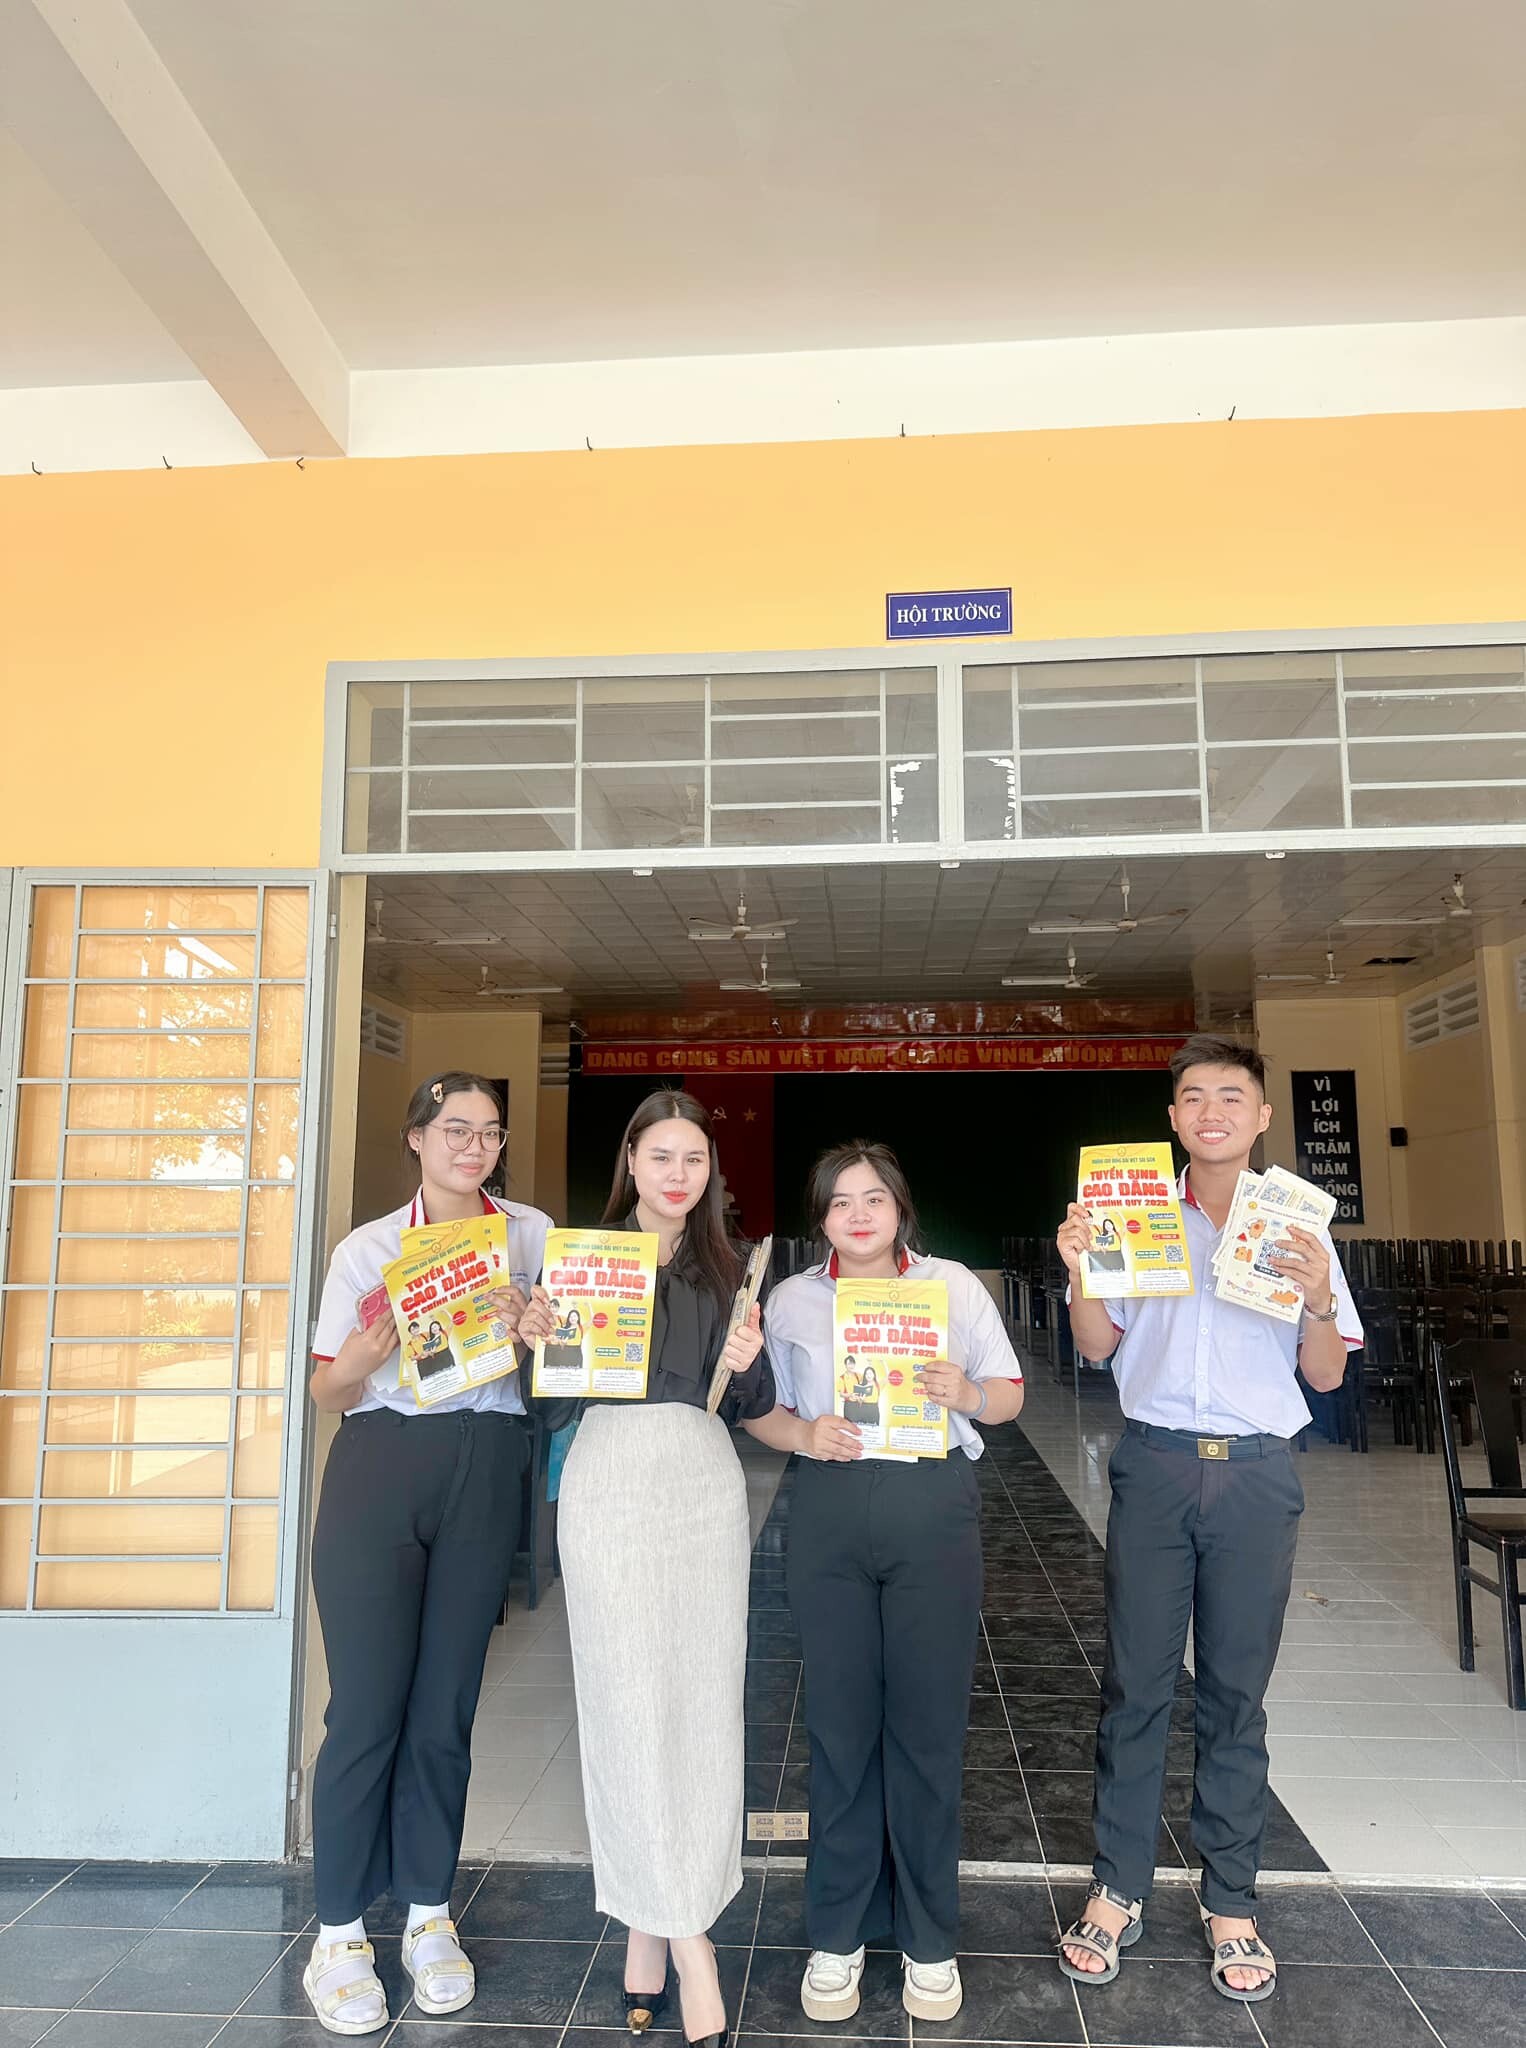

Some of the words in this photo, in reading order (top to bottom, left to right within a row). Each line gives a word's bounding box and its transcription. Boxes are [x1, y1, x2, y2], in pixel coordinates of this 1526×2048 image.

[896, 604, 927, 626] HỘI
[932, 602, 1001, 622] TRƯỜNG
[586, 1048, 649, 1068] ĐẢNG
[726, 1046, 770, 1065] SẢN
[835, 1049, 886, 1065] NAM
[977, 1048, 1035, 1064] VINH
[1314, 1076, 1331, 1091] VÌ
[1312, 1098, 1339, 1115] LỢI
[1314, 1118, 1340, 1133] ÍCH
[1304, 1139, 1351, 1154] TRĂM
[1090, 1166, 1124, 1180] TUYỂN
[1127, 1169, 1158, 1180] SINH
[1312, 1160, 1348, 1175] NĂM
[1082, 1182, 1112, 1198] CAO
[561, 1252, 603, 1268] TUYỂN
[608, 1258, 640, 1270] SINH
[405, 1266, 445, 1292] TUYỂN
[448, 1250, 476, 1271] SINH
[550, 1270, 588, 1285] CAO
[450, 1287, 466, 1300] QUY
[468, 1276, 490, 1292] 2025
[598, 1290, 616, 1298] QUY
[618, 1290, 644, 1300] 2025
[401, 1285, 438, 1312] CAO
[854, 1310, 894, 1325] TUYỂN
[899, 1314, 931, 1328] SINH
[844, 1328, 880, 1342] CAO
[892, 1347, 910, 1355] QUY
[912, 1348, 936, 1358] 2025
